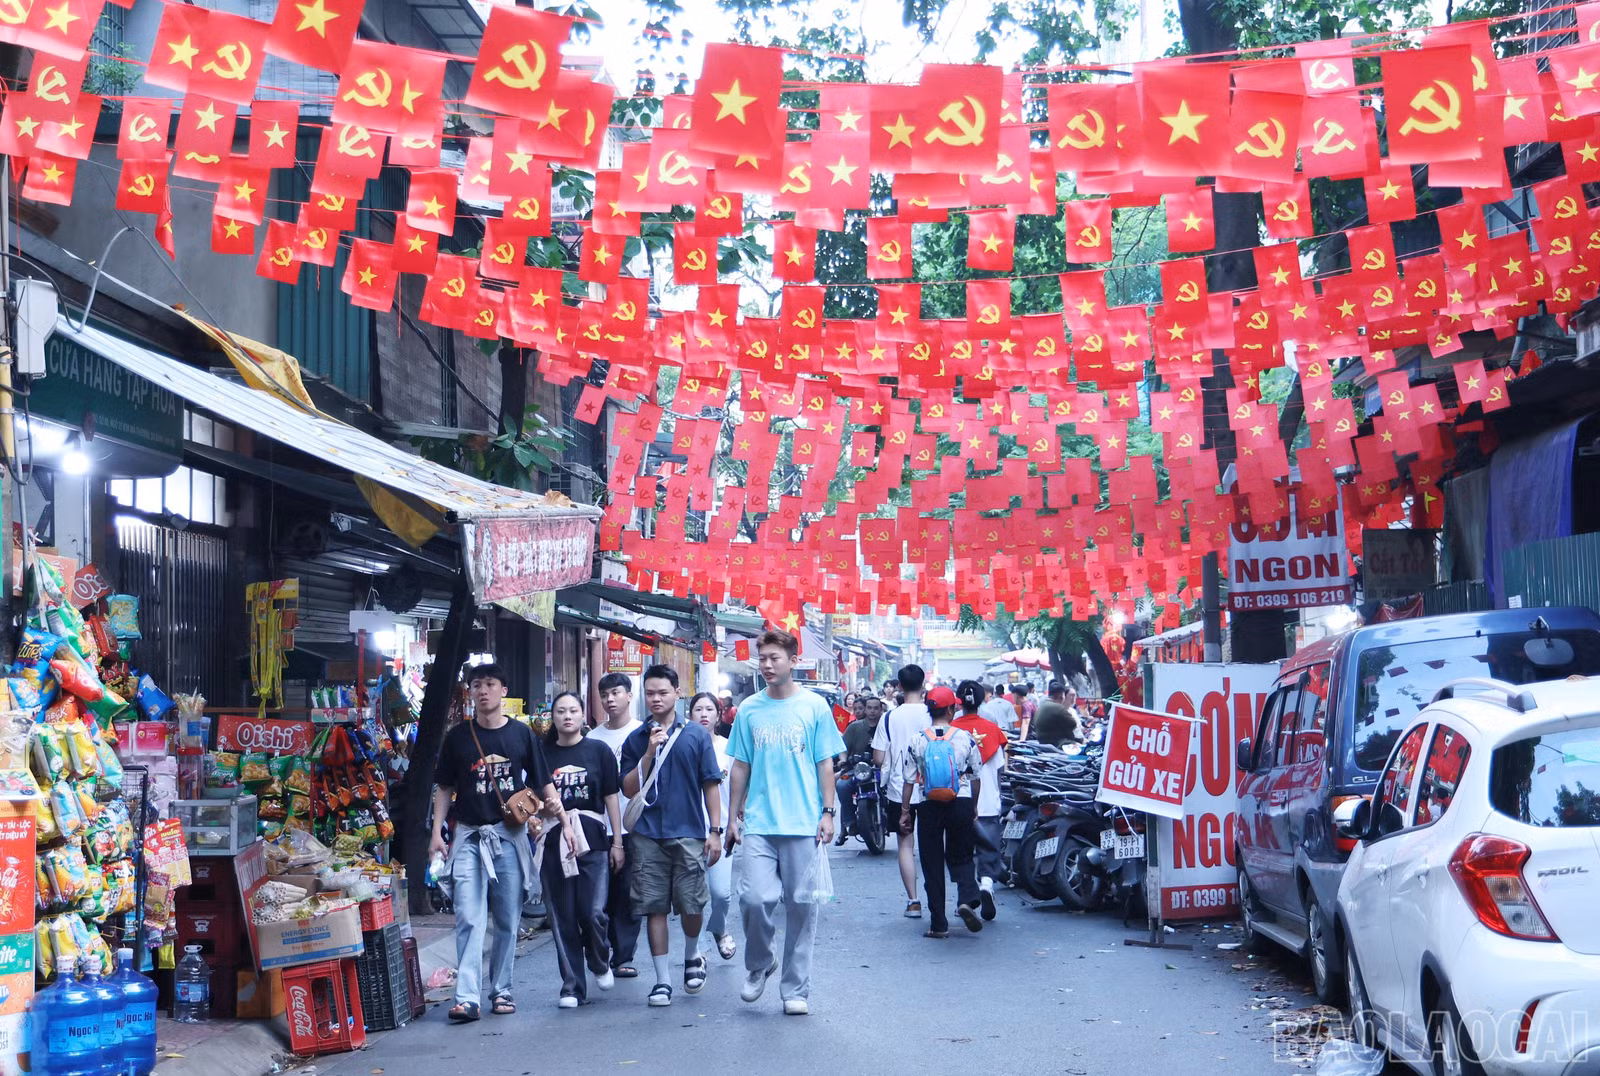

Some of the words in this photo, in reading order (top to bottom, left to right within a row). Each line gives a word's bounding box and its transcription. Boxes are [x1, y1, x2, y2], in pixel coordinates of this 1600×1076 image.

[1234, 553, 1340, 583] NGON
[1256, 594, 1289, 607] 0399
[1292, 592, 1318, 605] 106
[1321, 589, 1345, 602] 219
[236, 722, 295, 750] Oishi
[1127, 721, 1171, 757] CHỖ
[1108, 755, 1146, 791] GỬI
[1150, 768, 1182, 799] XE
[1352, 776, 1376, 784] GL
[1193, 888, 1226, 907] 0399
